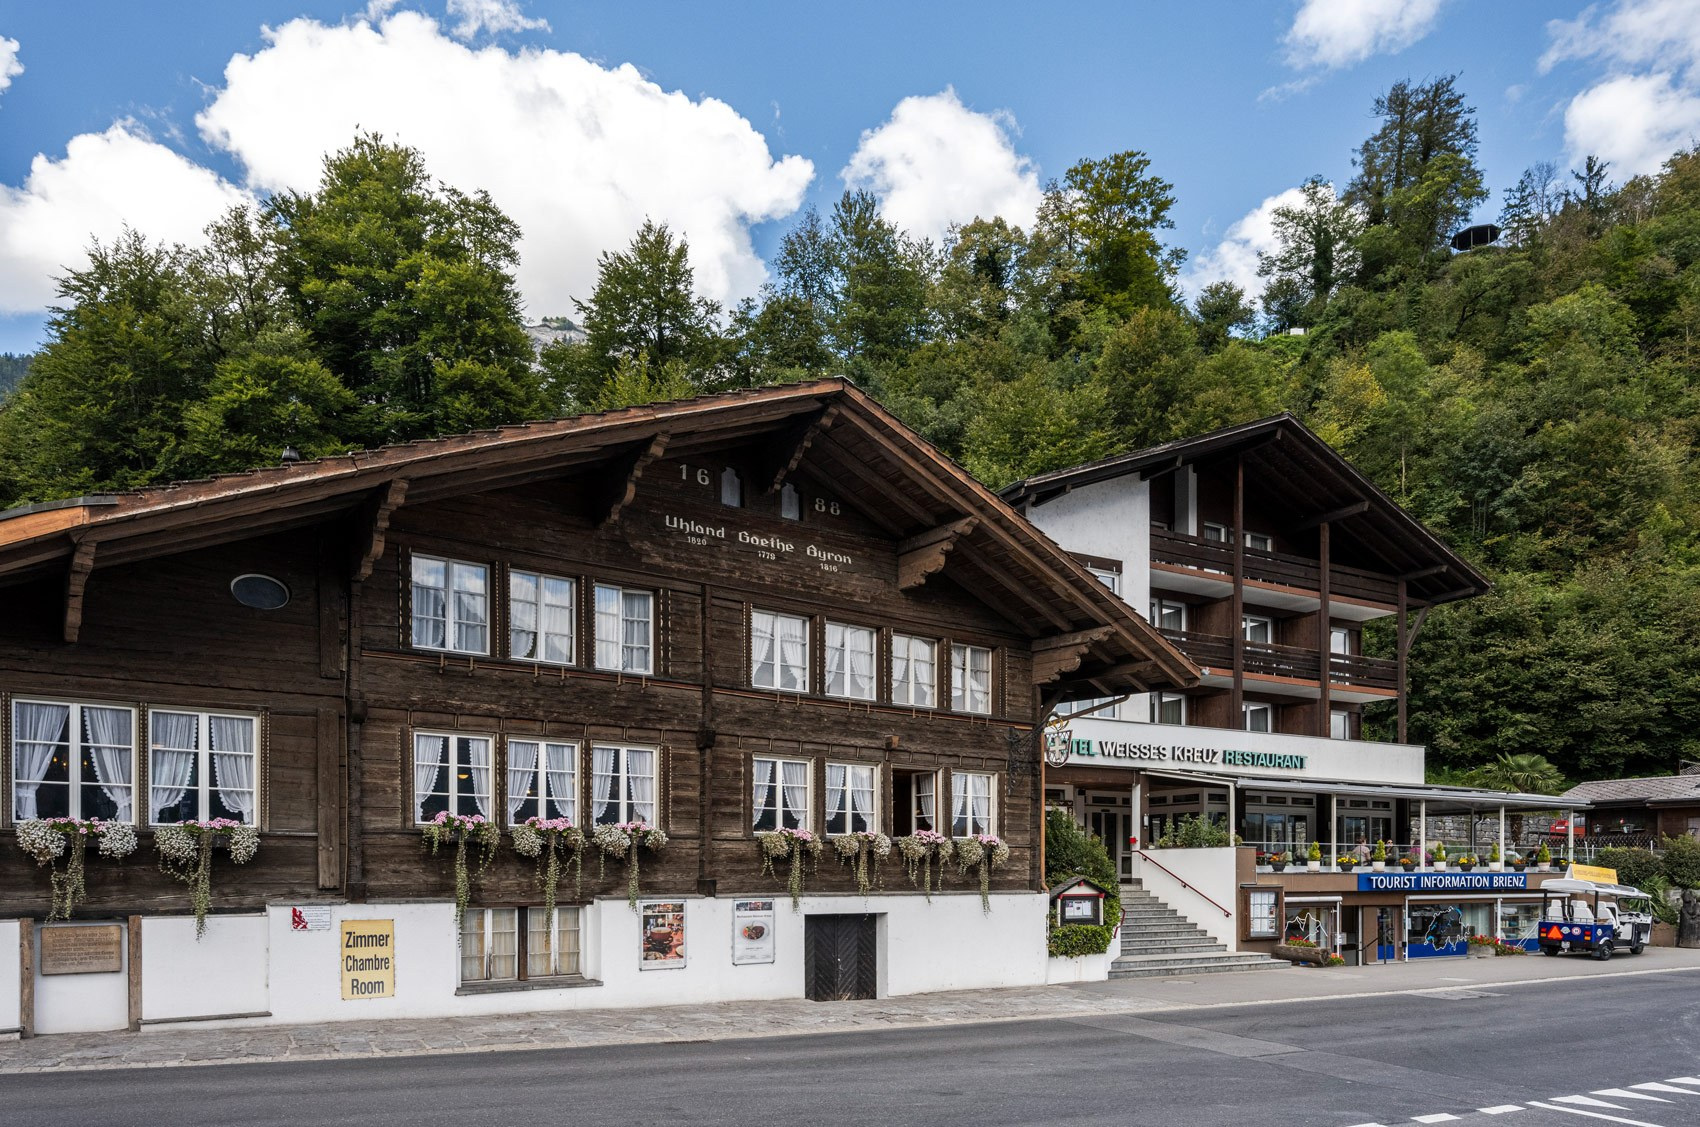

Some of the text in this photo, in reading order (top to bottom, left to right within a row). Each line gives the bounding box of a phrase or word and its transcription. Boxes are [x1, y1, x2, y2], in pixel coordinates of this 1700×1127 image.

[679, 464, 841, 516] 16 88
[665, 514, 852, 565] Uhland Goethe Byron
[687, 535, 838, 573] 1820 1779 1816
[1100, 740, 1170, 760] WEISSES
[1172, 746, 1220, 764] KREUZ
[1222, 749, 1308, 770] RESTAURANT
[1370, 875, 1525, 889] TOURIST INFORMATION BRIENZ
[345, 931, 390, 948] Zimmer
[345, 954, 390, 972] Chambre
[351, 978, 385, 995] Room
